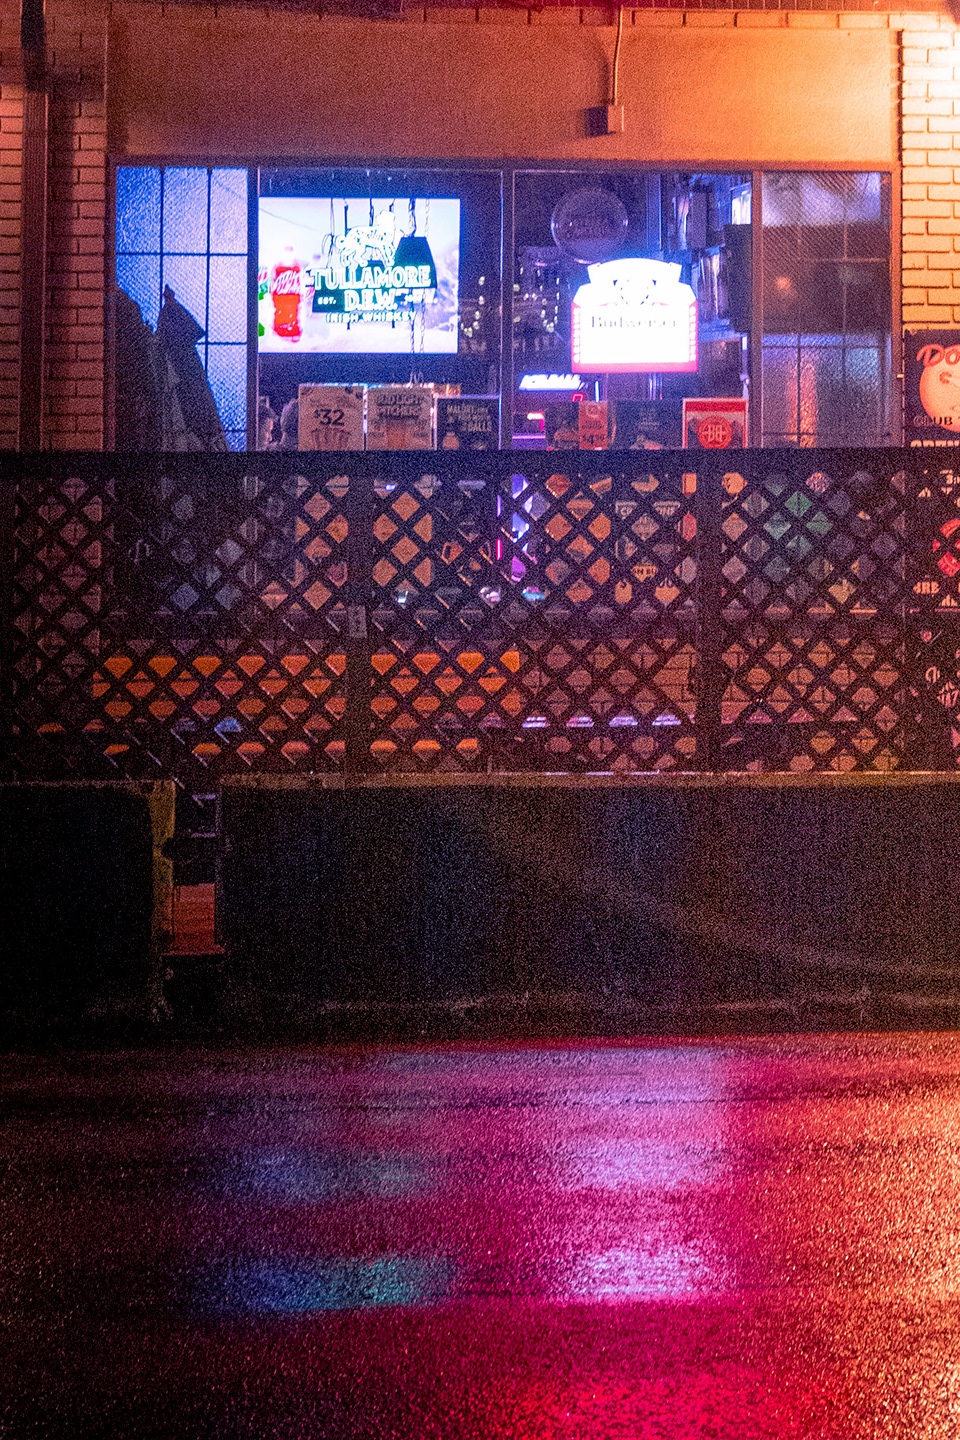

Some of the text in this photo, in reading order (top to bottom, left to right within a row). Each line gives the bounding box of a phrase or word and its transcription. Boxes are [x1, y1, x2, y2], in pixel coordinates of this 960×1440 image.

[312, 265, 433, 291] TULLAMORE
[362, 311, 416, 324] WHISKEY
[314, 408, 346, 426] $32
